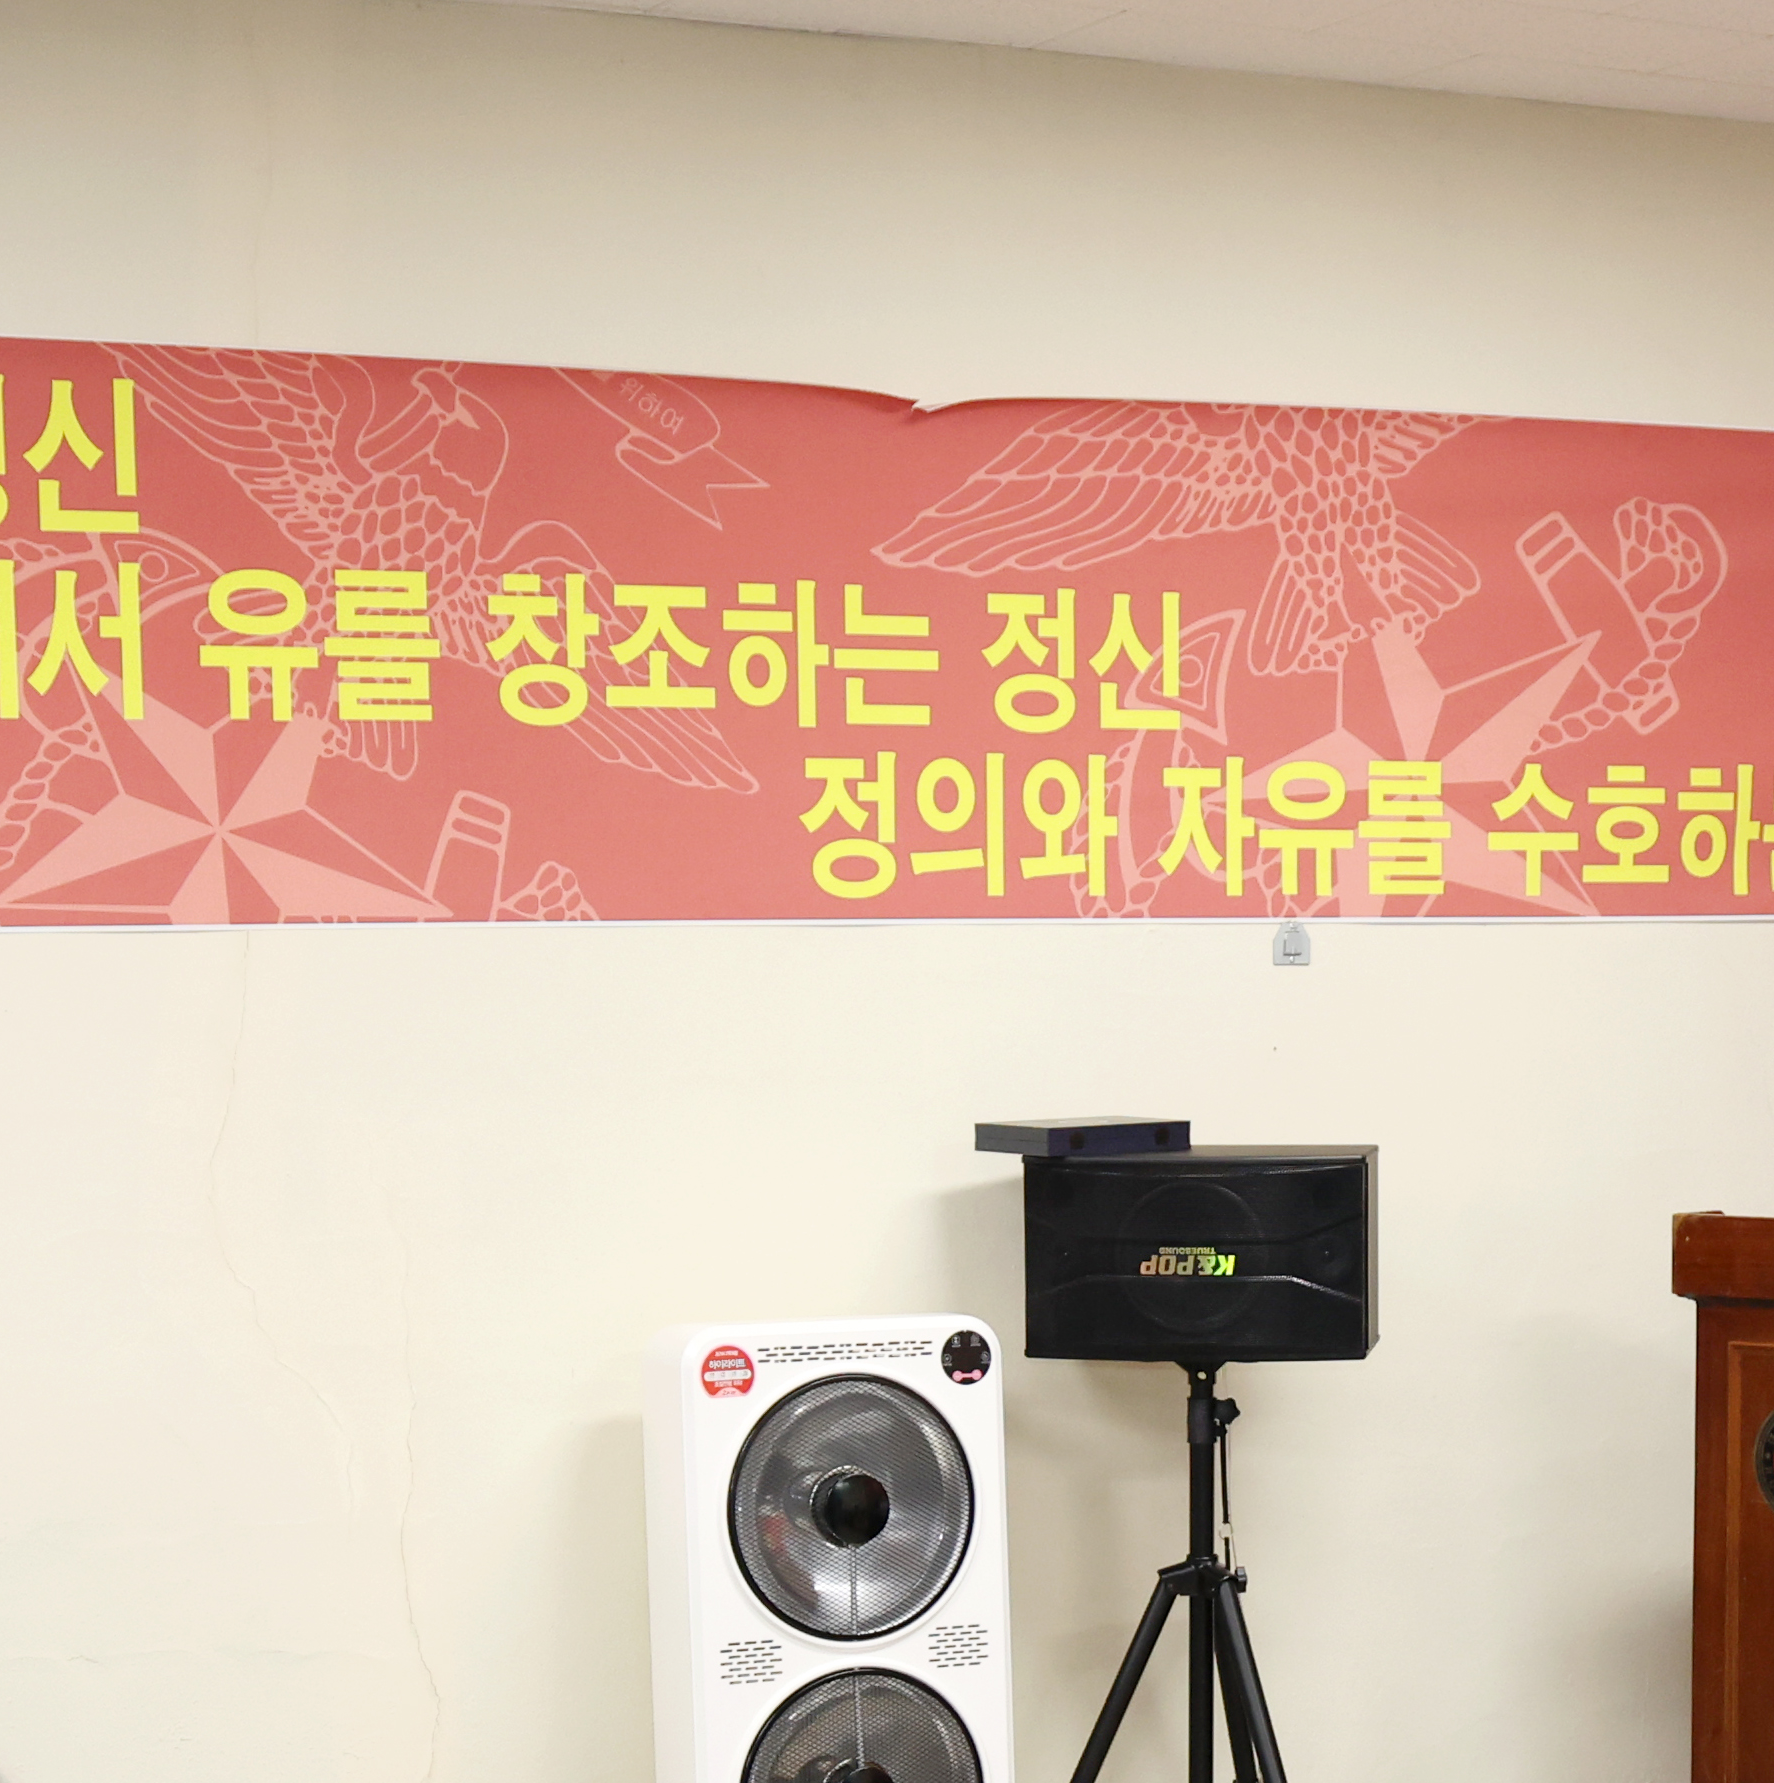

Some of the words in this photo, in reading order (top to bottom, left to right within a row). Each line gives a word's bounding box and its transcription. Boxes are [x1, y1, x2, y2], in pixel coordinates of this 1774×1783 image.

[620, 377, 684, 435] 위하여
[200, 570, 441, 721] 유를
[487, 574, 939, 727] 창조하는
[983, 589, 1181, 733] 정신
[800, 752, 1118, 898] 정의와
[1159, 757, 1451, 896] 자유를
[1140, 1254, 1236, 1276] K&POP
